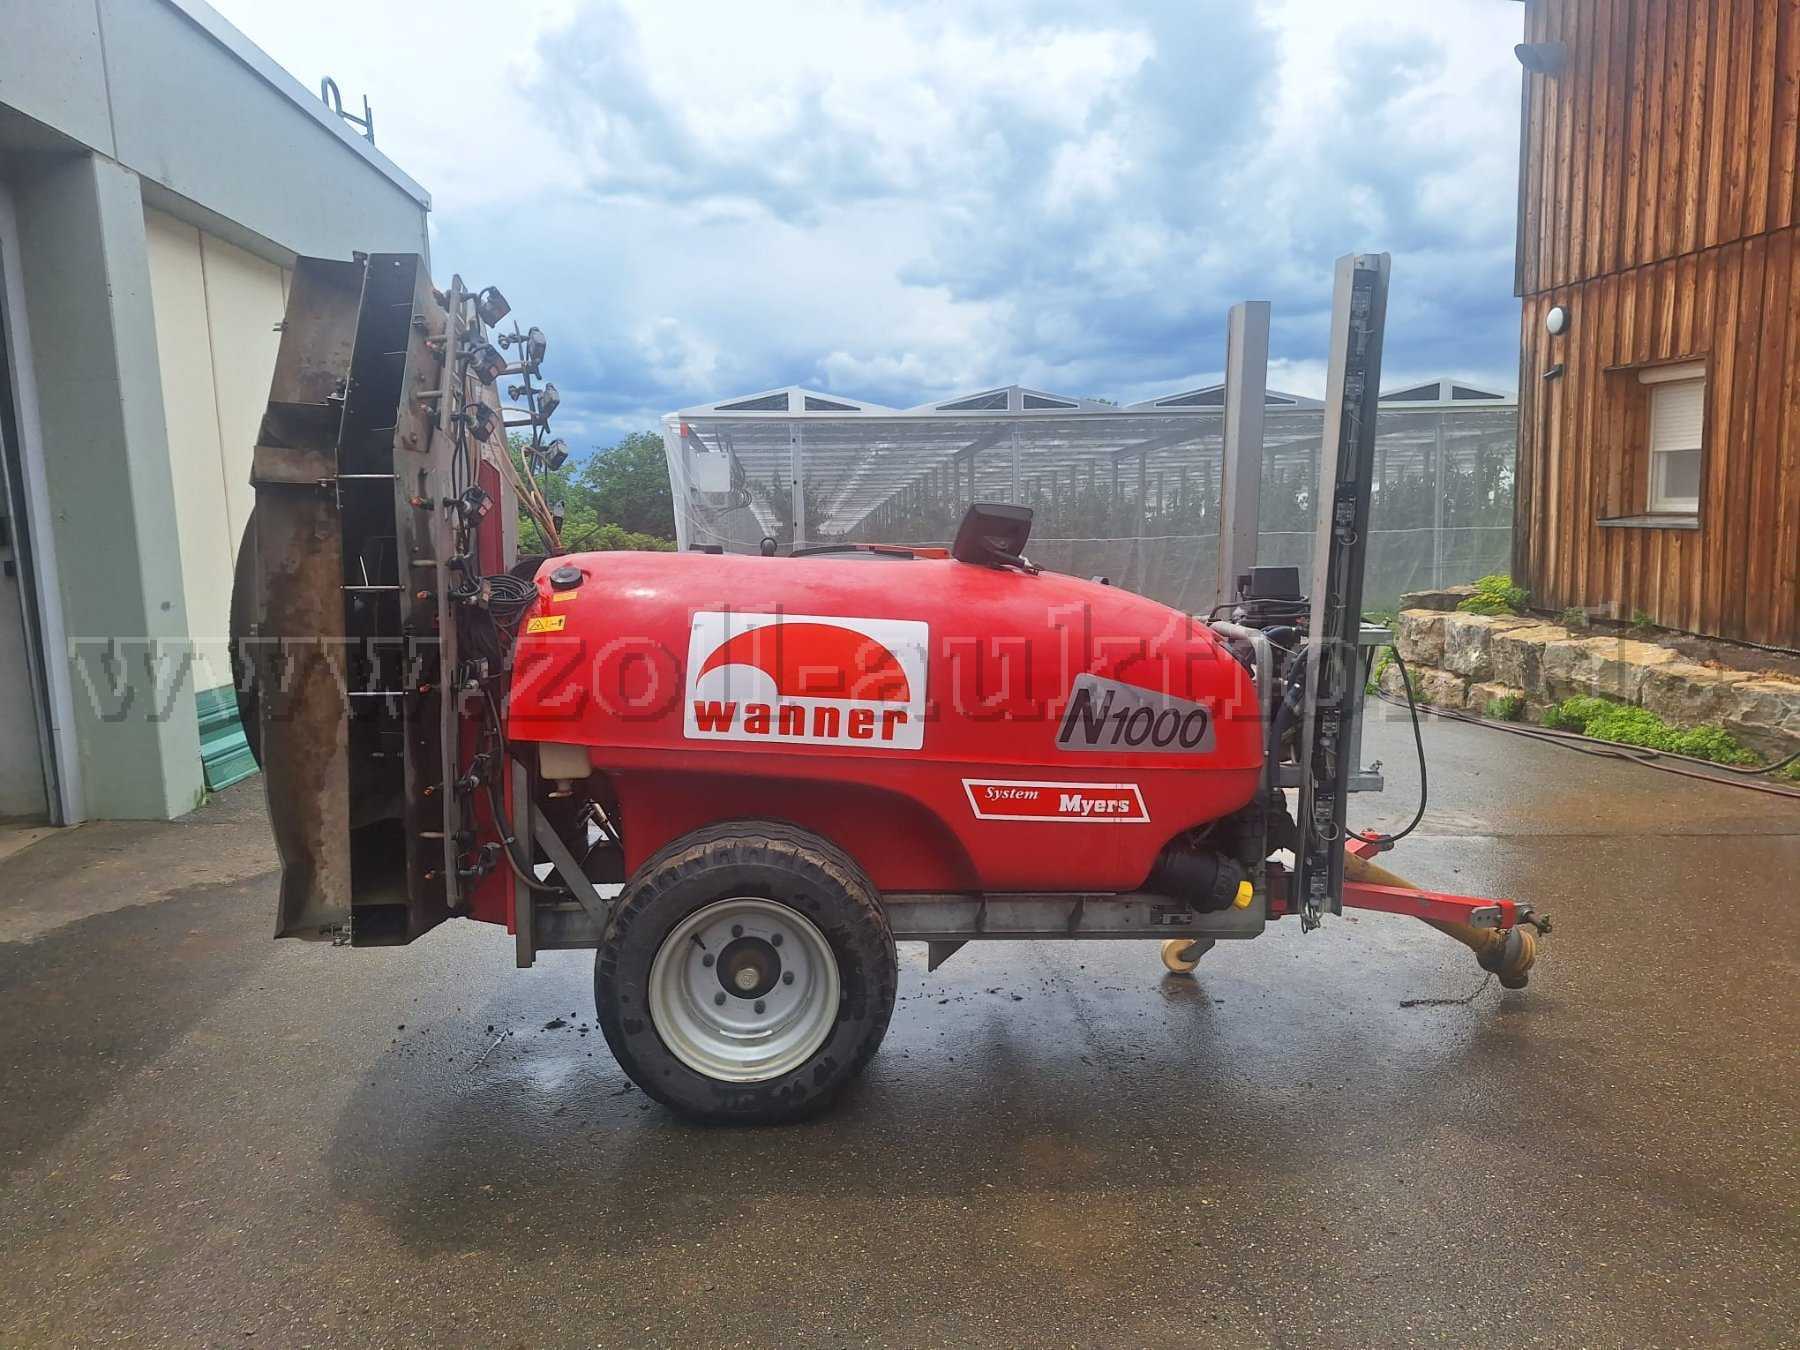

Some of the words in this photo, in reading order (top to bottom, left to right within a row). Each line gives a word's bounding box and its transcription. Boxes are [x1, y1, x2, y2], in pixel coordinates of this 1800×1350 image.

[693, 700, 908, 741] wanner
[1058, 688, 1208, 748] N1000
[984, 786, 1039, 801] System
[1058, 794, 1130, 816] Myers
